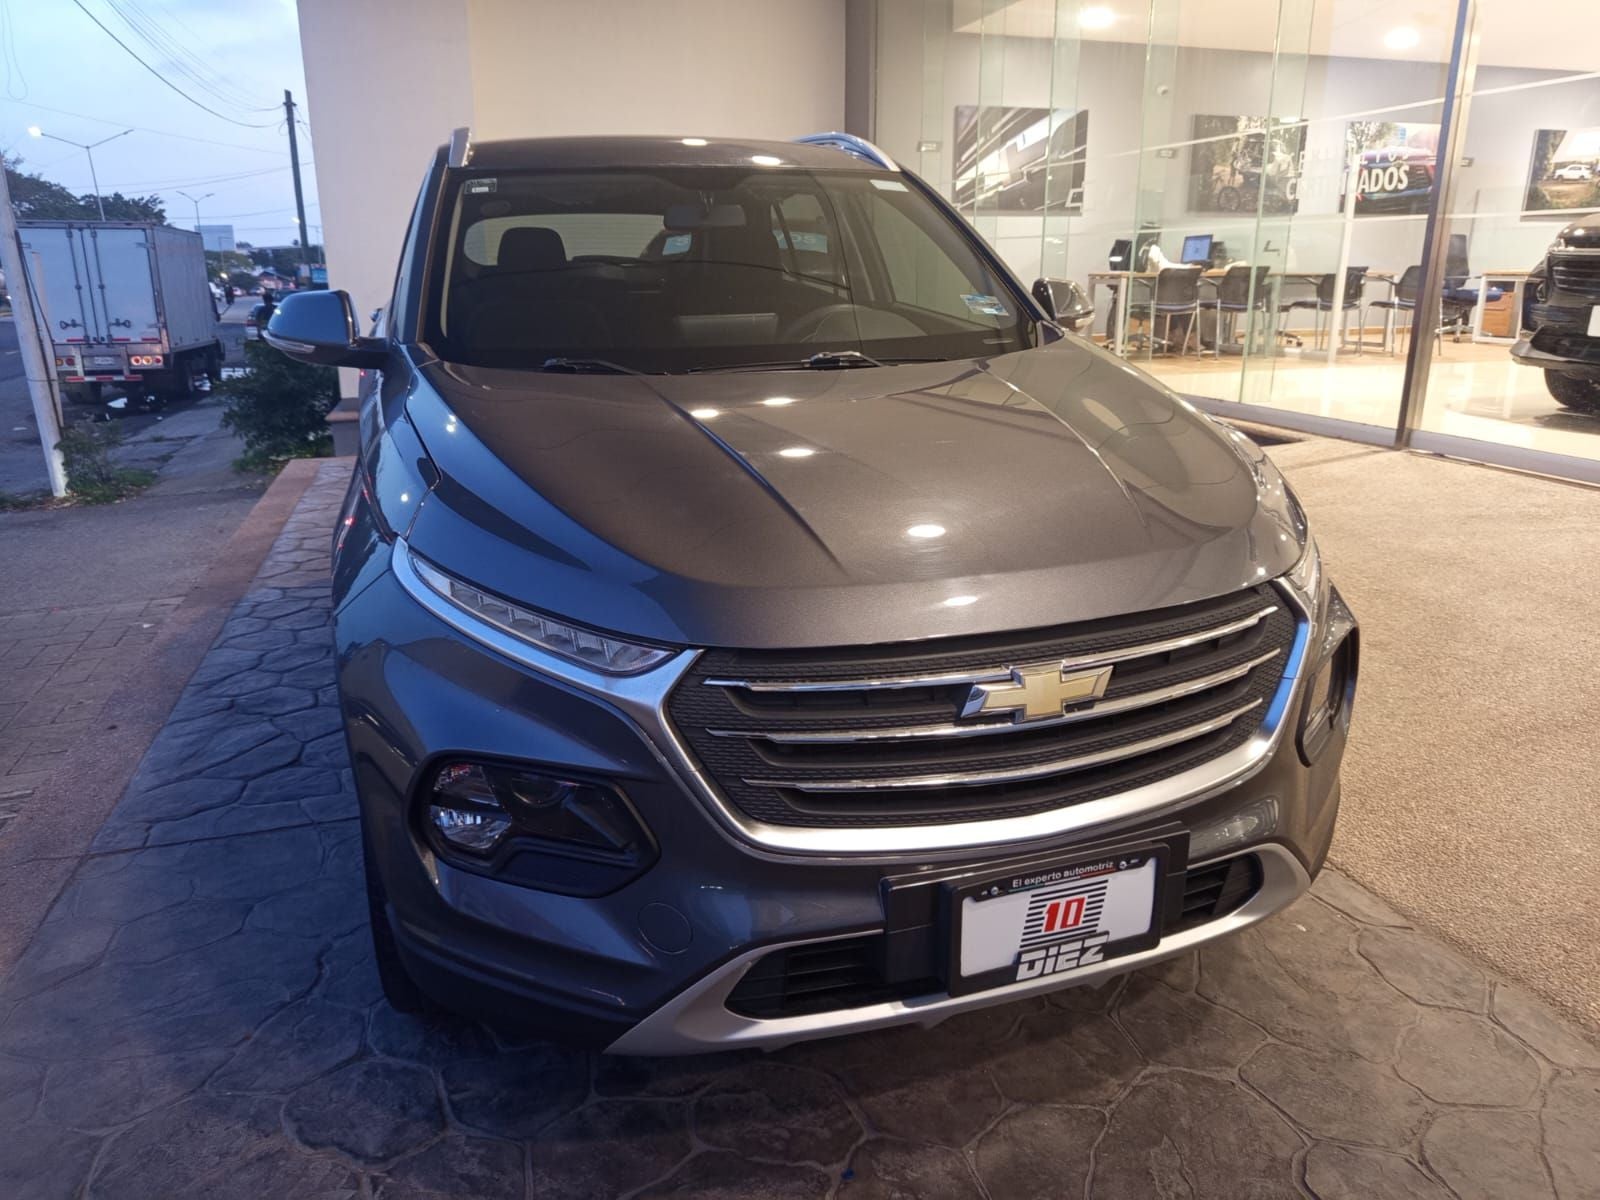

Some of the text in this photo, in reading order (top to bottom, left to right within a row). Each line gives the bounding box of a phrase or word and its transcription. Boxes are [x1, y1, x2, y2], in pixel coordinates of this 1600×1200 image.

[1012, 879, 1023, 888] El
[1024, 871, 1061, 886] experto
[1063, 861, 1114, 878] automotriz
[1043, 897, 1086, 932] 10
